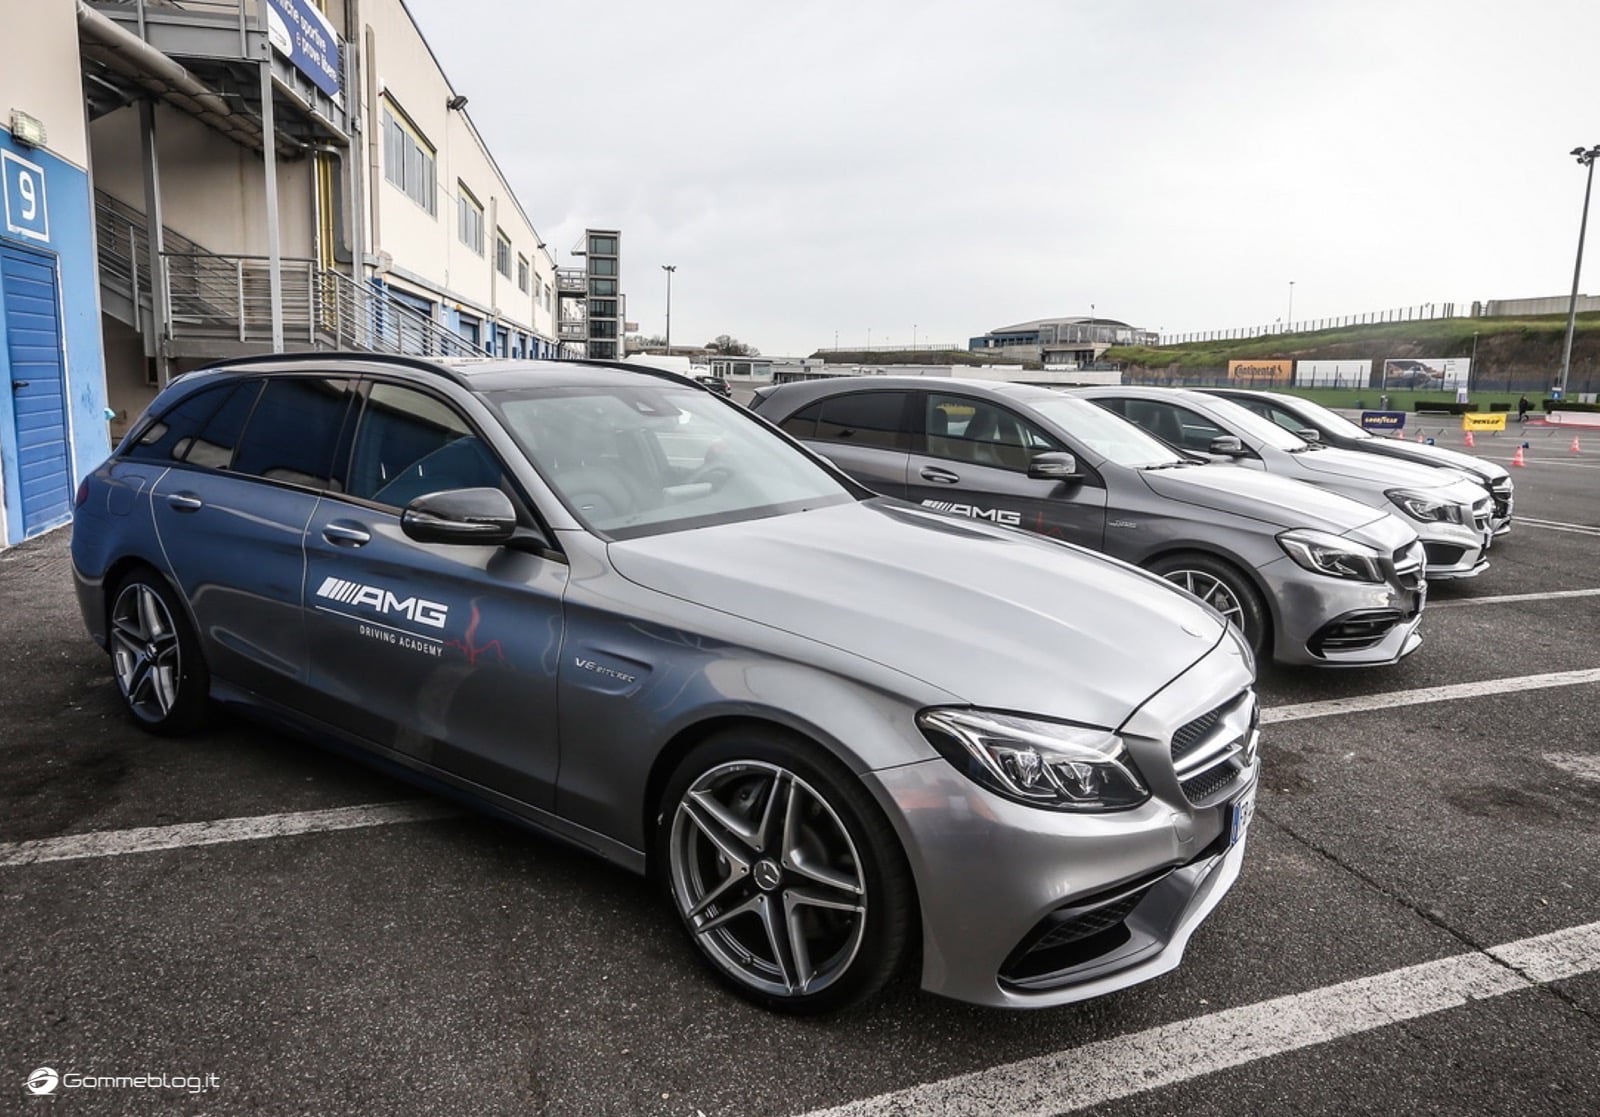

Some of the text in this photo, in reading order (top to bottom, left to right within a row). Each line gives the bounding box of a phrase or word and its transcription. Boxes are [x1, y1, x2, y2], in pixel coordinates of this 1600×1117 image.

[19, 170, 36, 221] 9
[1235, 364, 1277, 378] Continental
[1364, 416, 1398, 424] GOODYEAR
[351, 585, 449, 629] AMG
[359, 624, 444, 657] DRIVING ACADEMY
